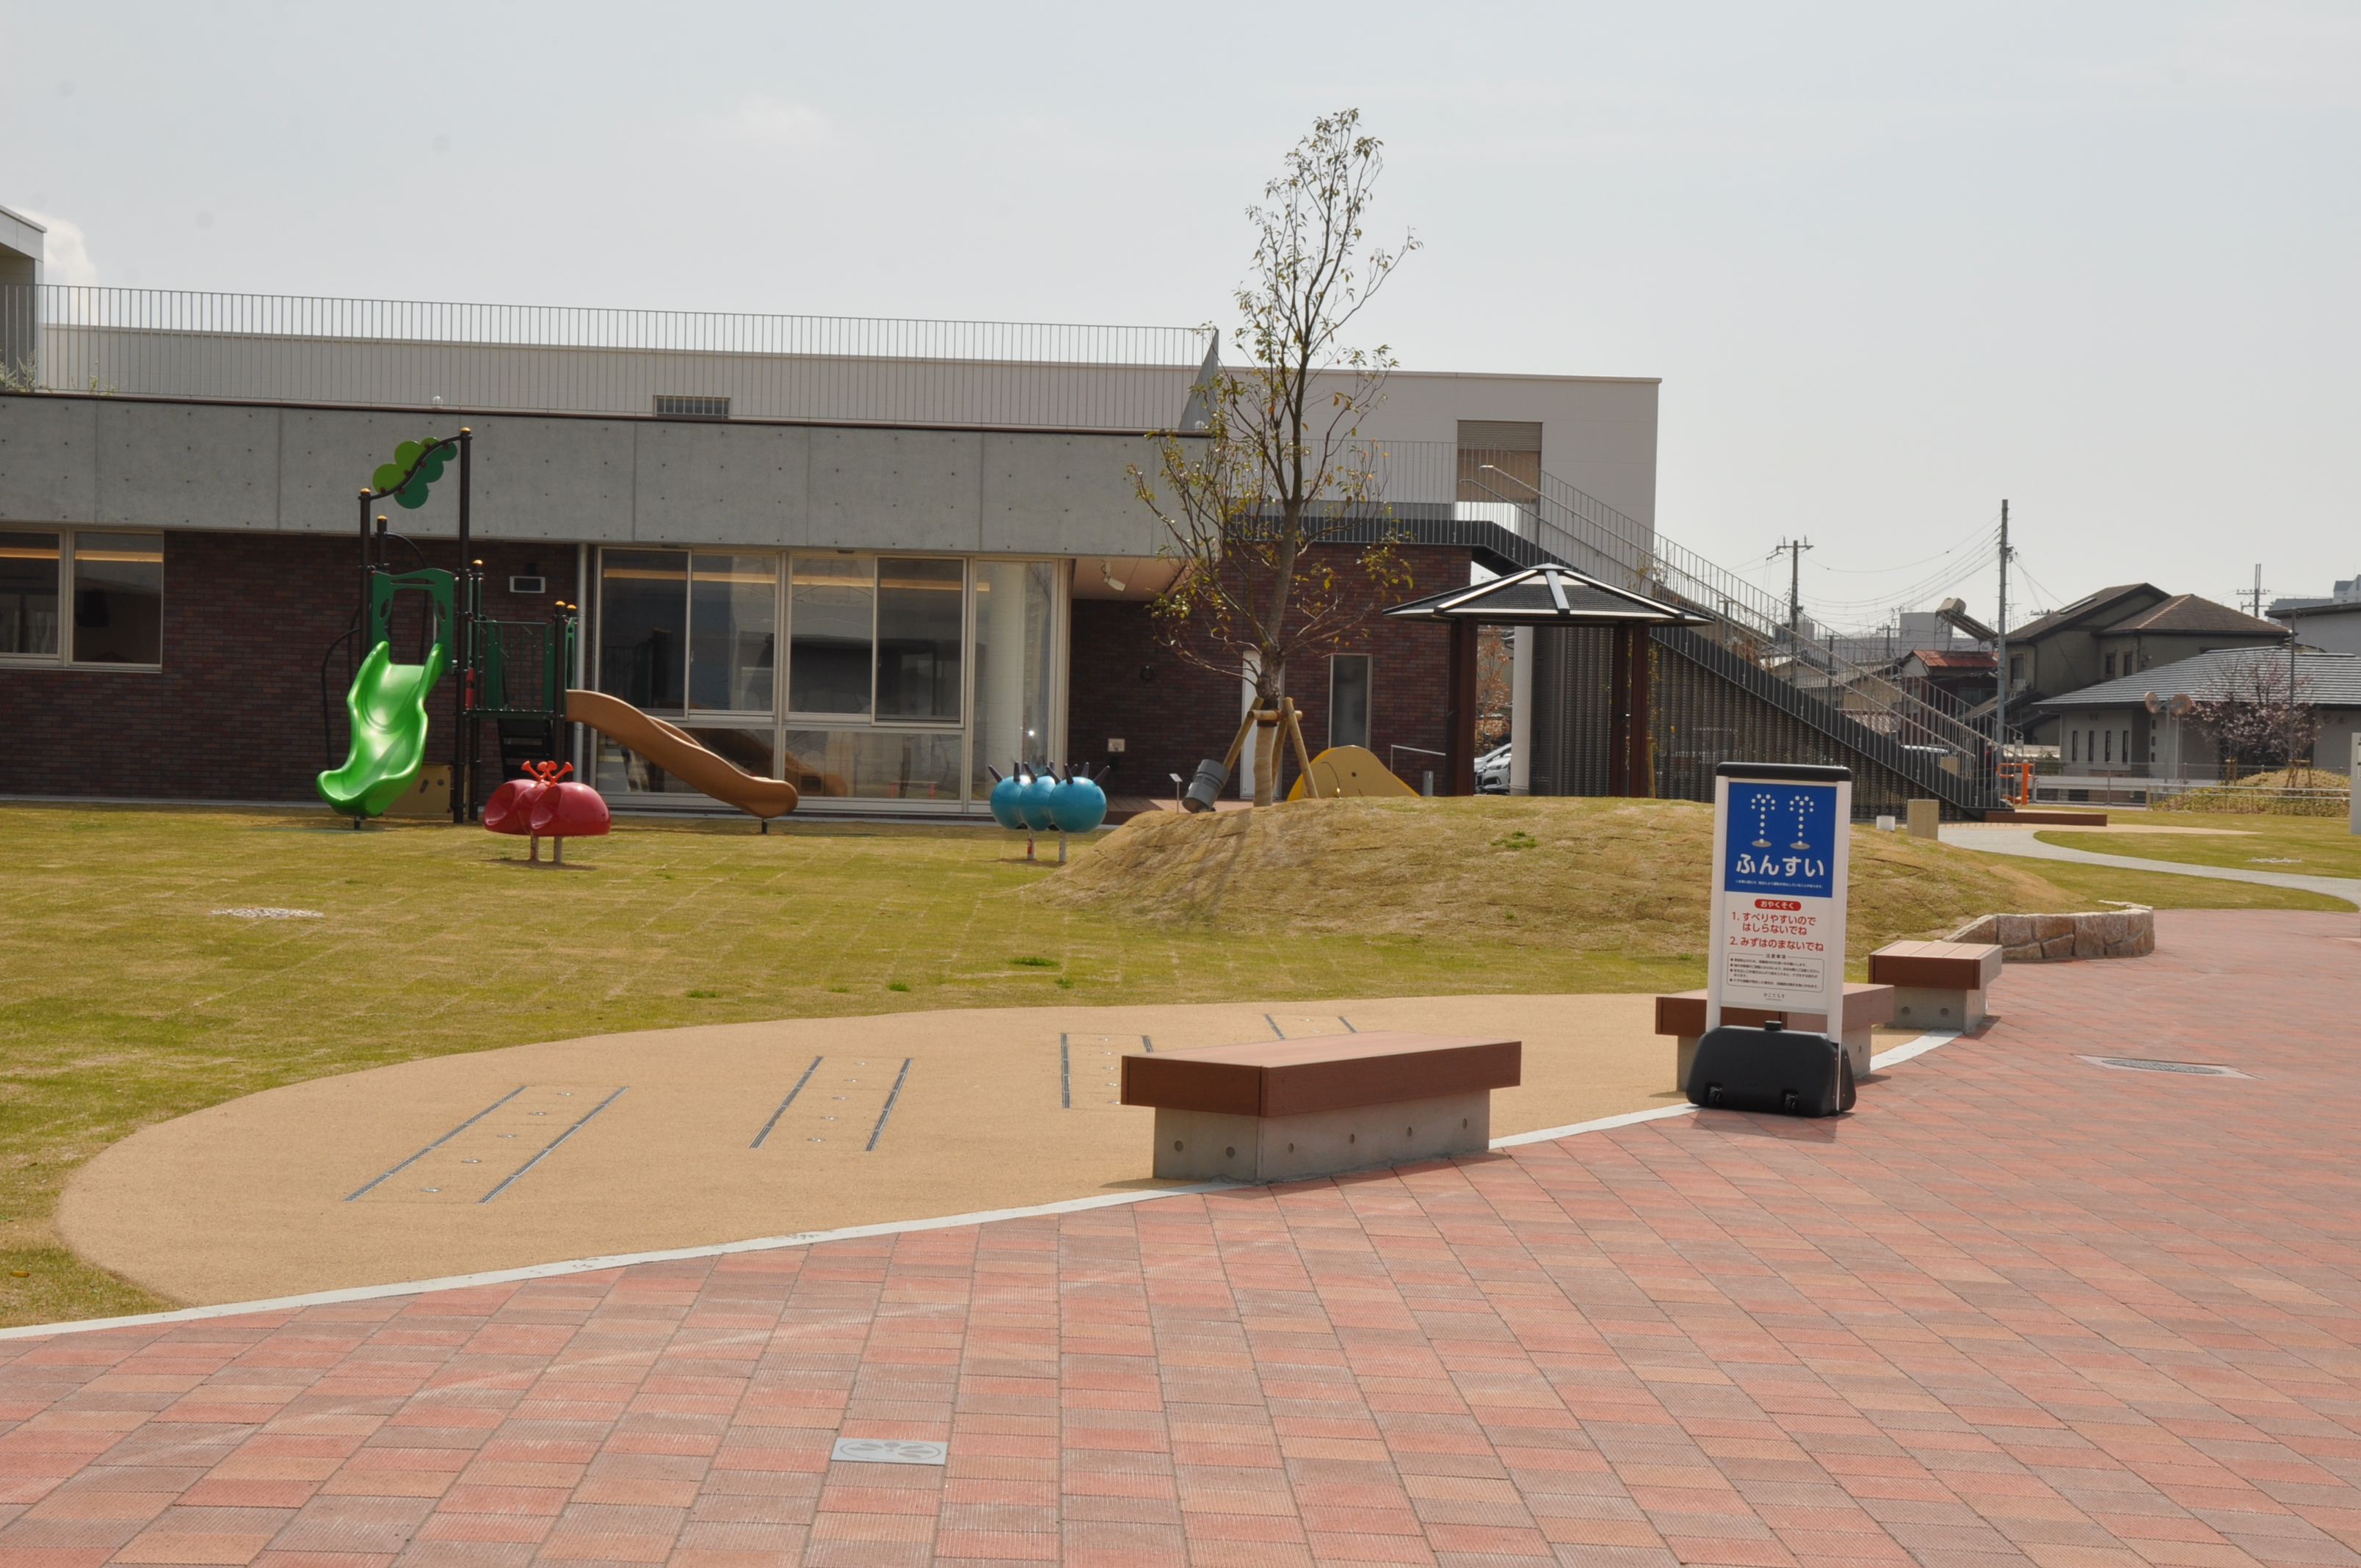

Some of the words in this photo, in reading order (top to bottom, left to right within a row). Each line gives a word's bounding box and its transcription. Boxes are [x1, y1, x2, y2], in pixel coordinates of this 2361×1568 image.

[1736, 854, 1824, 877] ふんすい
[1760, 901, 1794, 909] おやくそく
[1742, 912, 1816, 926] すべりやすいので
[1742, 923, 1807, 935] はしらないでね
[1741, 937, 1824, 951] みずはのまないでね
